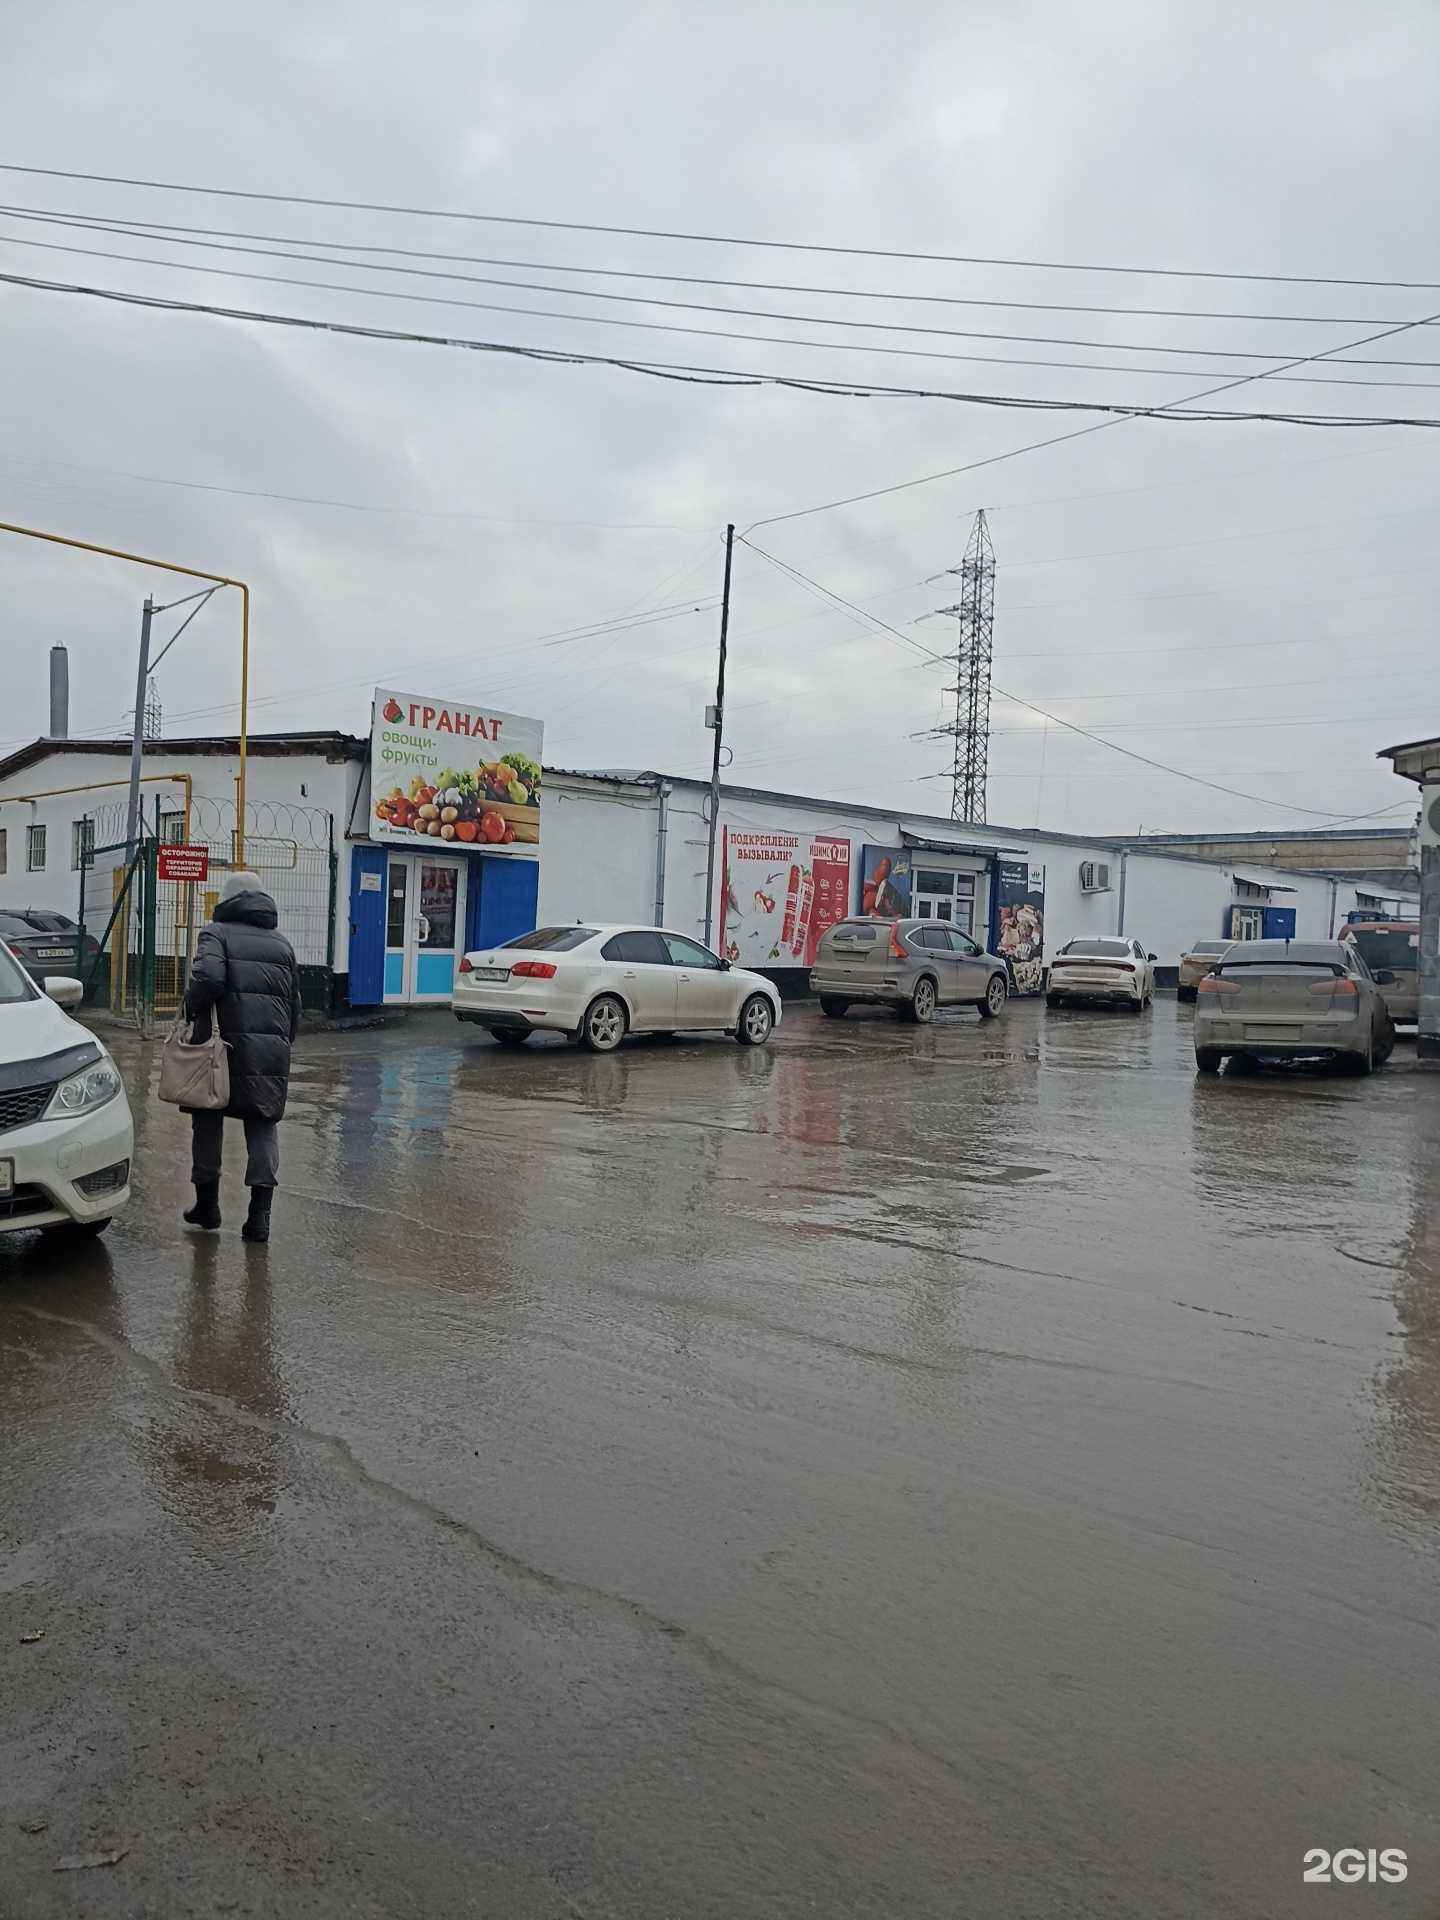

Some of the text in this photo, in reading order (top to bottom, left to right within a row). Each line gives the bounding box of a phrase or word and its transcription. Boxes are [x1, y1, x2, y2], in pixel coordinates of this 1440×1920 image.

[408, 703, 503, 742] ГРАНАТ
[382, 731, 437, 749] овощи-
[381, 747, 438, 766] фрукты
[730, 833, 799, 848] ПОДКРЕПЛЕНИЕ
[161, 848, 206, 857] ОСТОРОЖНО!
[737, 848, 793, 862] ВЫЗЫВАЛИ?
